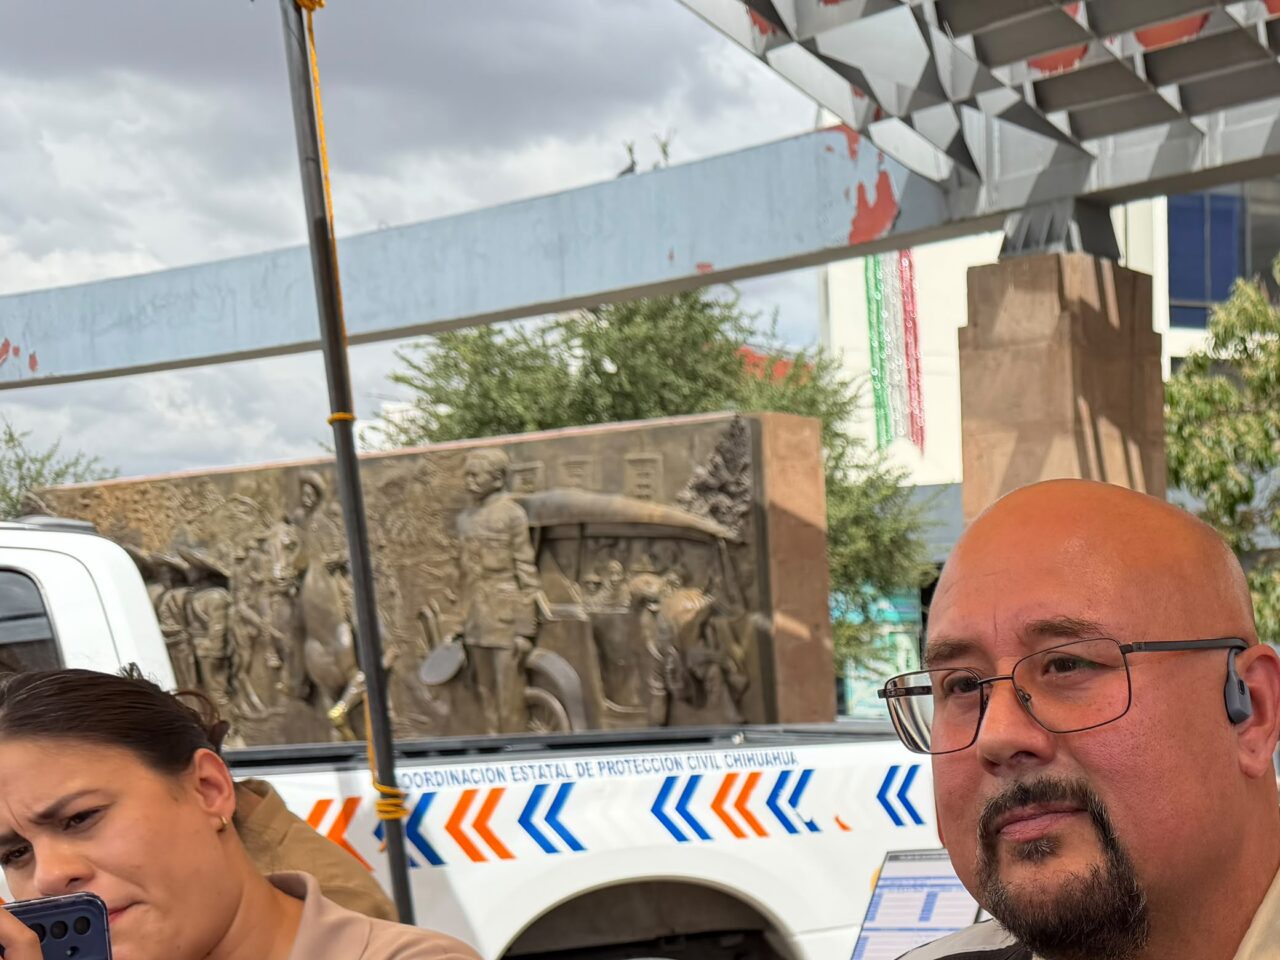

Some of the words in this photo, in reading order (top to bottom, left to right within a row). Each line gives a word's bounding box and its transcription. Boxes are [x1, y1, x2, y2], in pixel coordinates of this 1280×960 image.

[402, 767, 507, 789] OORDINACION
[511, 762, 572, 782] ESTATAL
[575, 761, 594, 778] DE
[687, 754, 722, 770] CIVIL
[724, 751, 799, 768] CHIHUAHUA
